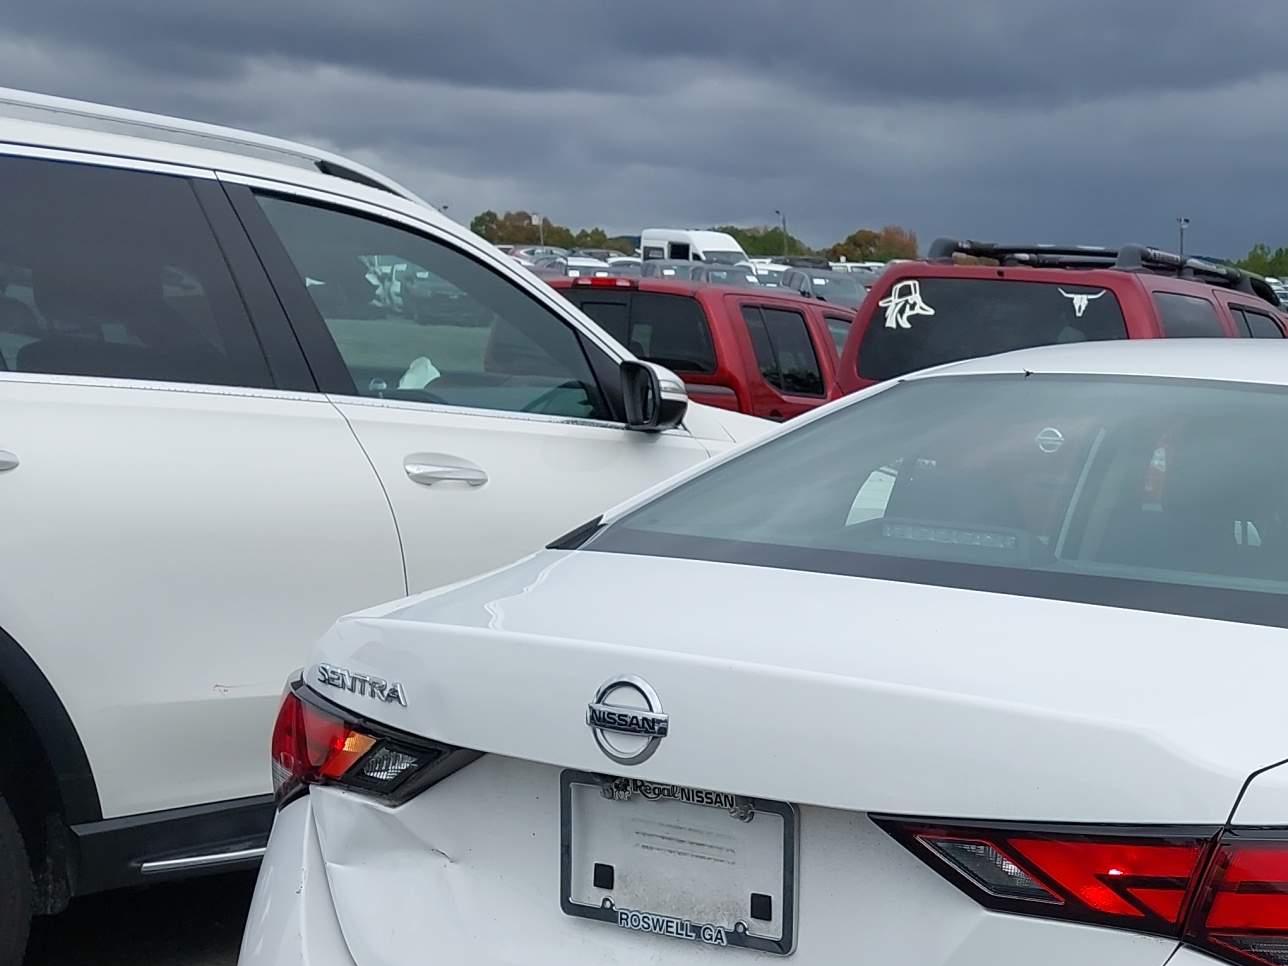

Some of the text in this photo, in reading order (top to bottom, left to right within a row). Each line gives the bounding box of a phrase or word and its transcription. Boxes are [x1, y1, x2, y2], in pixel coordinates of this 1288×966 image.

[317, 662, 408, 707] SENTRA
[590, 708, 657, 731] NISSAN
[631, 778, 736, 809] Regal NISSAN
[618, 910, 728, 946] ROSWELL GA
